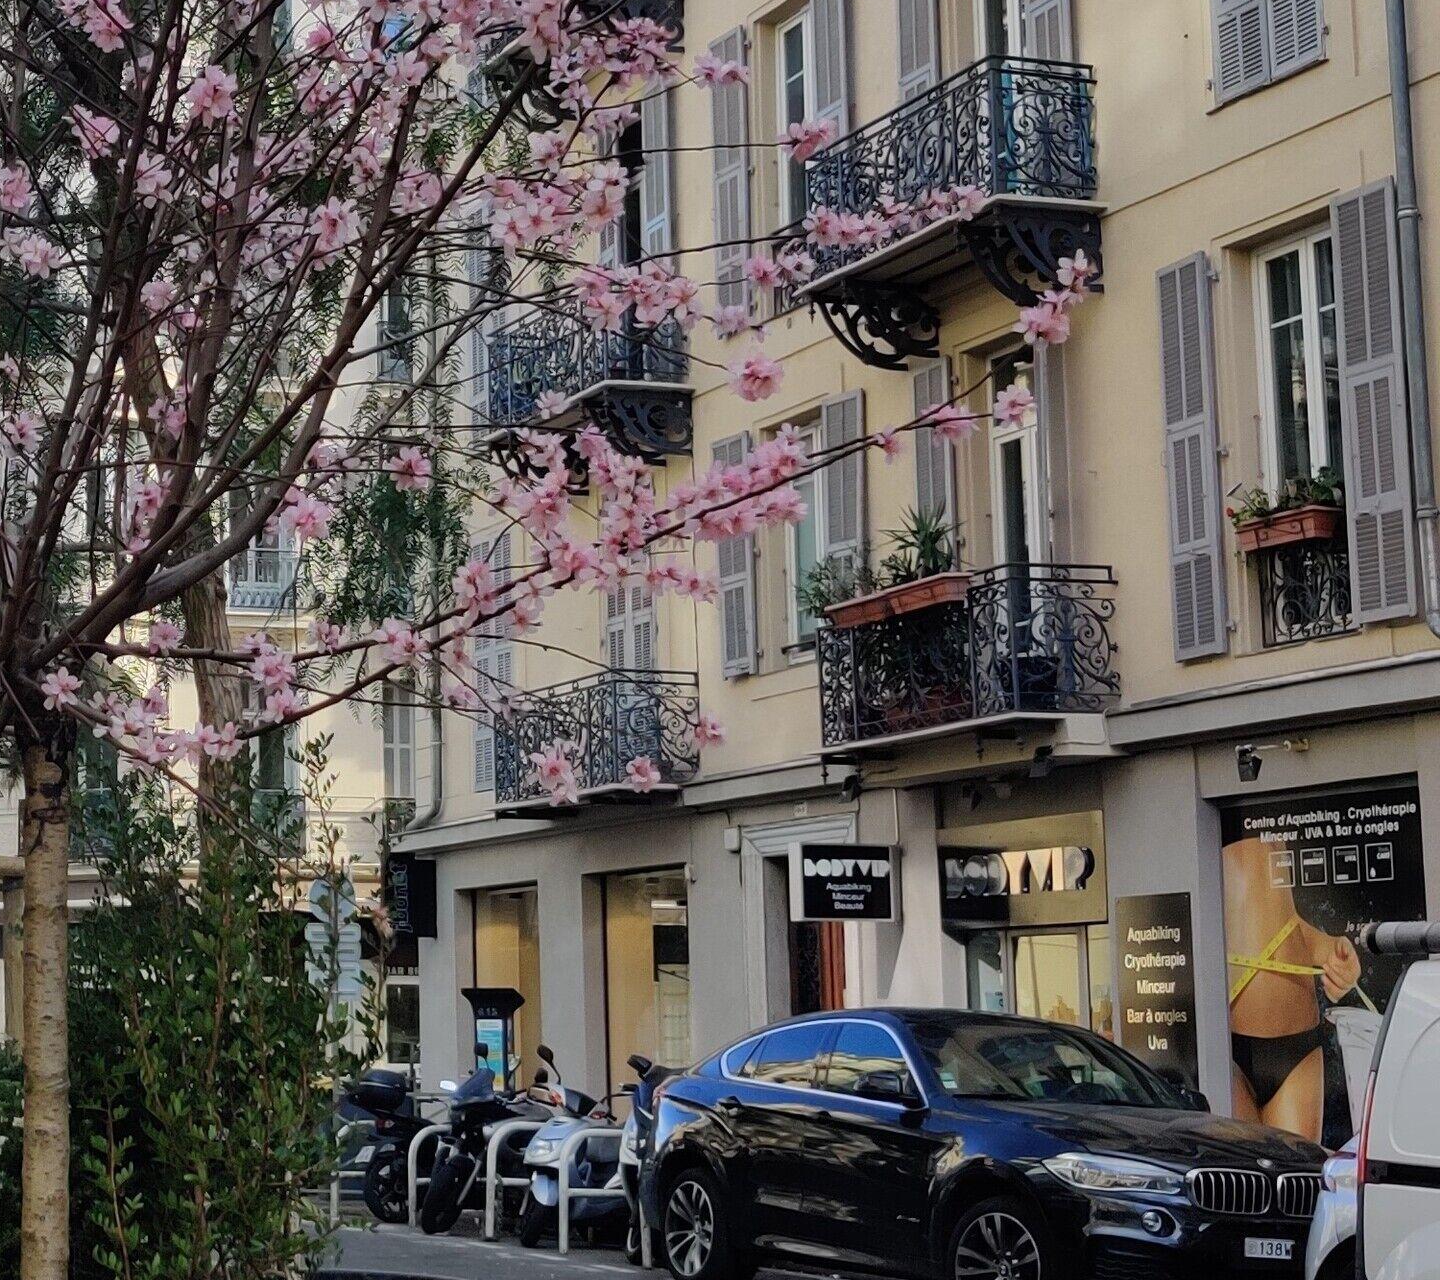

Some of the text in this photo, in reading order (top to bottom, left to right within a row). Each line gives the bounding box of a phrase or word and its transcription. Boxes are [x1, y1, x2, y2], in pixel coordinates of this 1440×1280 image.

[1244, 817, 1275, 830] Centre
[1277, 810, 1340, 827] d'Aquabiking
[1348, 802, 1416, 821] Cryothérapie
[1260, 831, 1297, 843] Minceur
[1304, 828, 1323, 840] UVA
[1326, 826, 1333, 837] &
[1335, 824, 1352, 836] Bar
[1364, 820, 1399, 835] ongles
[826, 882, 872, 893] Aquabiking
[832, 892, 865, 901] Minceur
[1127, 926, 1181, 943] Aquabiking
[1124, 951, 1186, 972] Cryothérapie
[1136, 979, 1176, 994] Minceur
[1126, 1008, 1187, 1026] Bar à ongles
[1147, 1034, 1168, 1050] Uva
